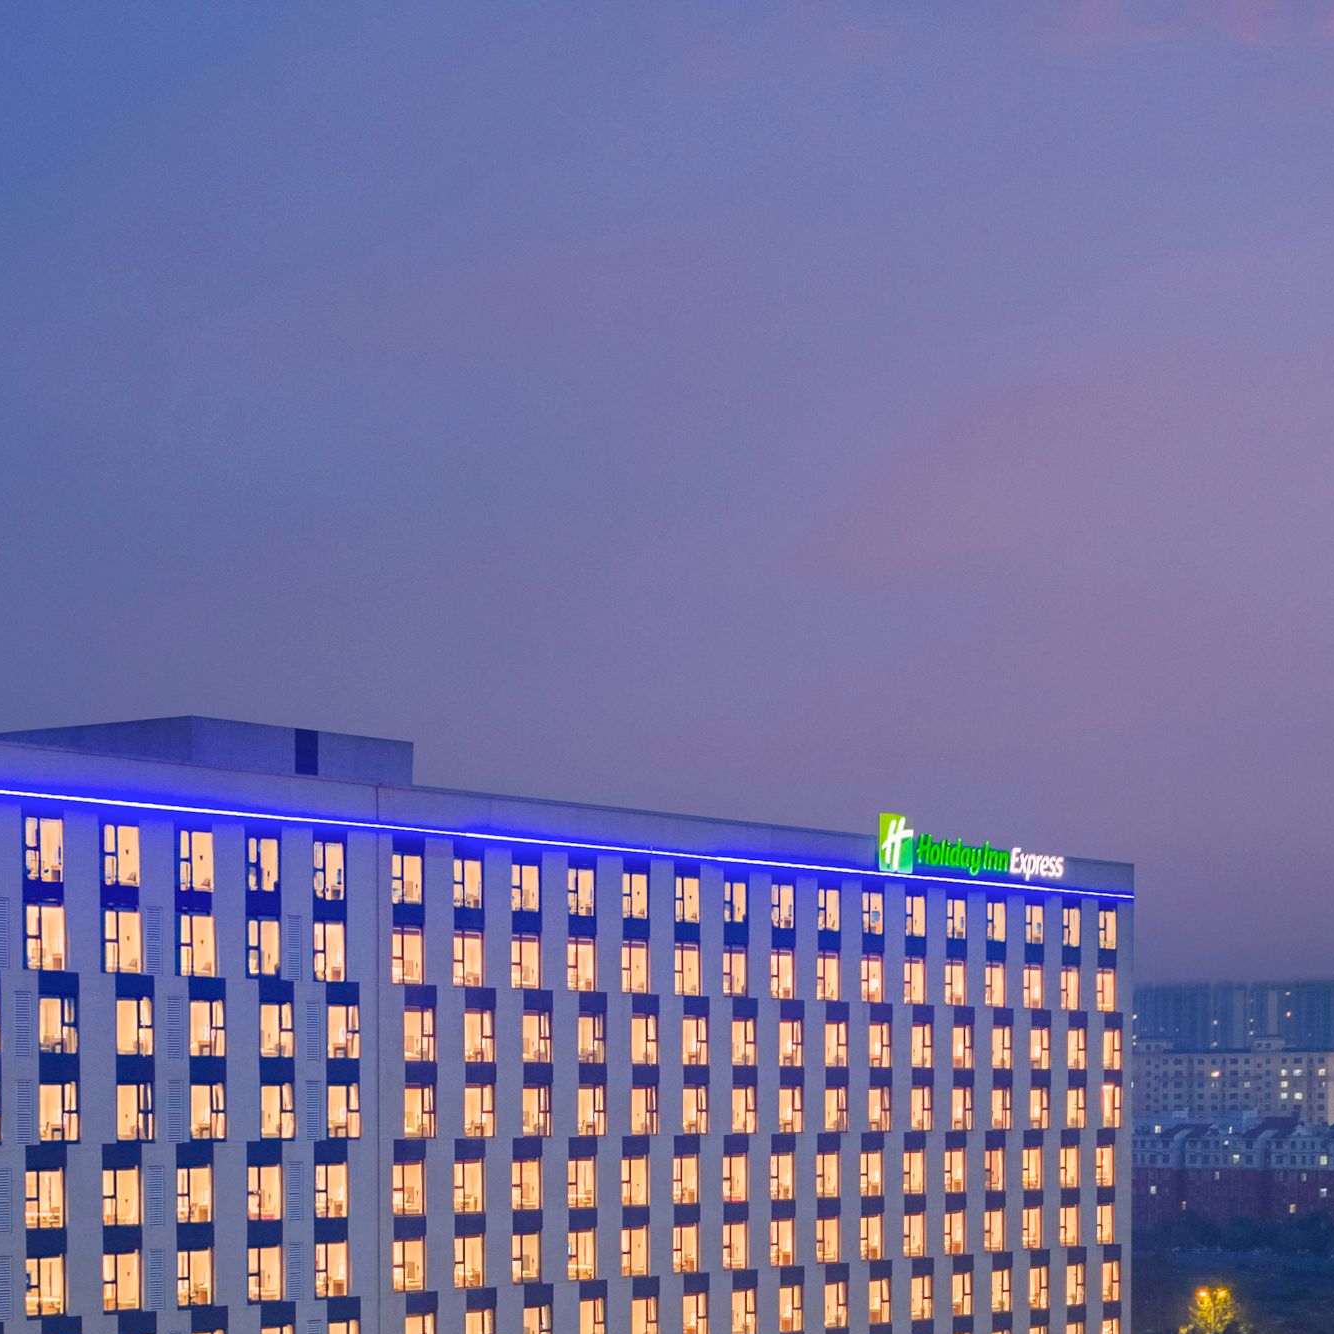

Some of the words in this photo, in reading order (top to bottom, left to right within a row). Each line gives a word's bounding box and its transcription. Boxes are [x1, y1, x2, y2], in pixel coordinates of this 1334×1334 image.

[917, 834, 982, 876] Holiday
[983, 841, 1010, 872] Inn
[1009, 847, 1065, 881] Express
